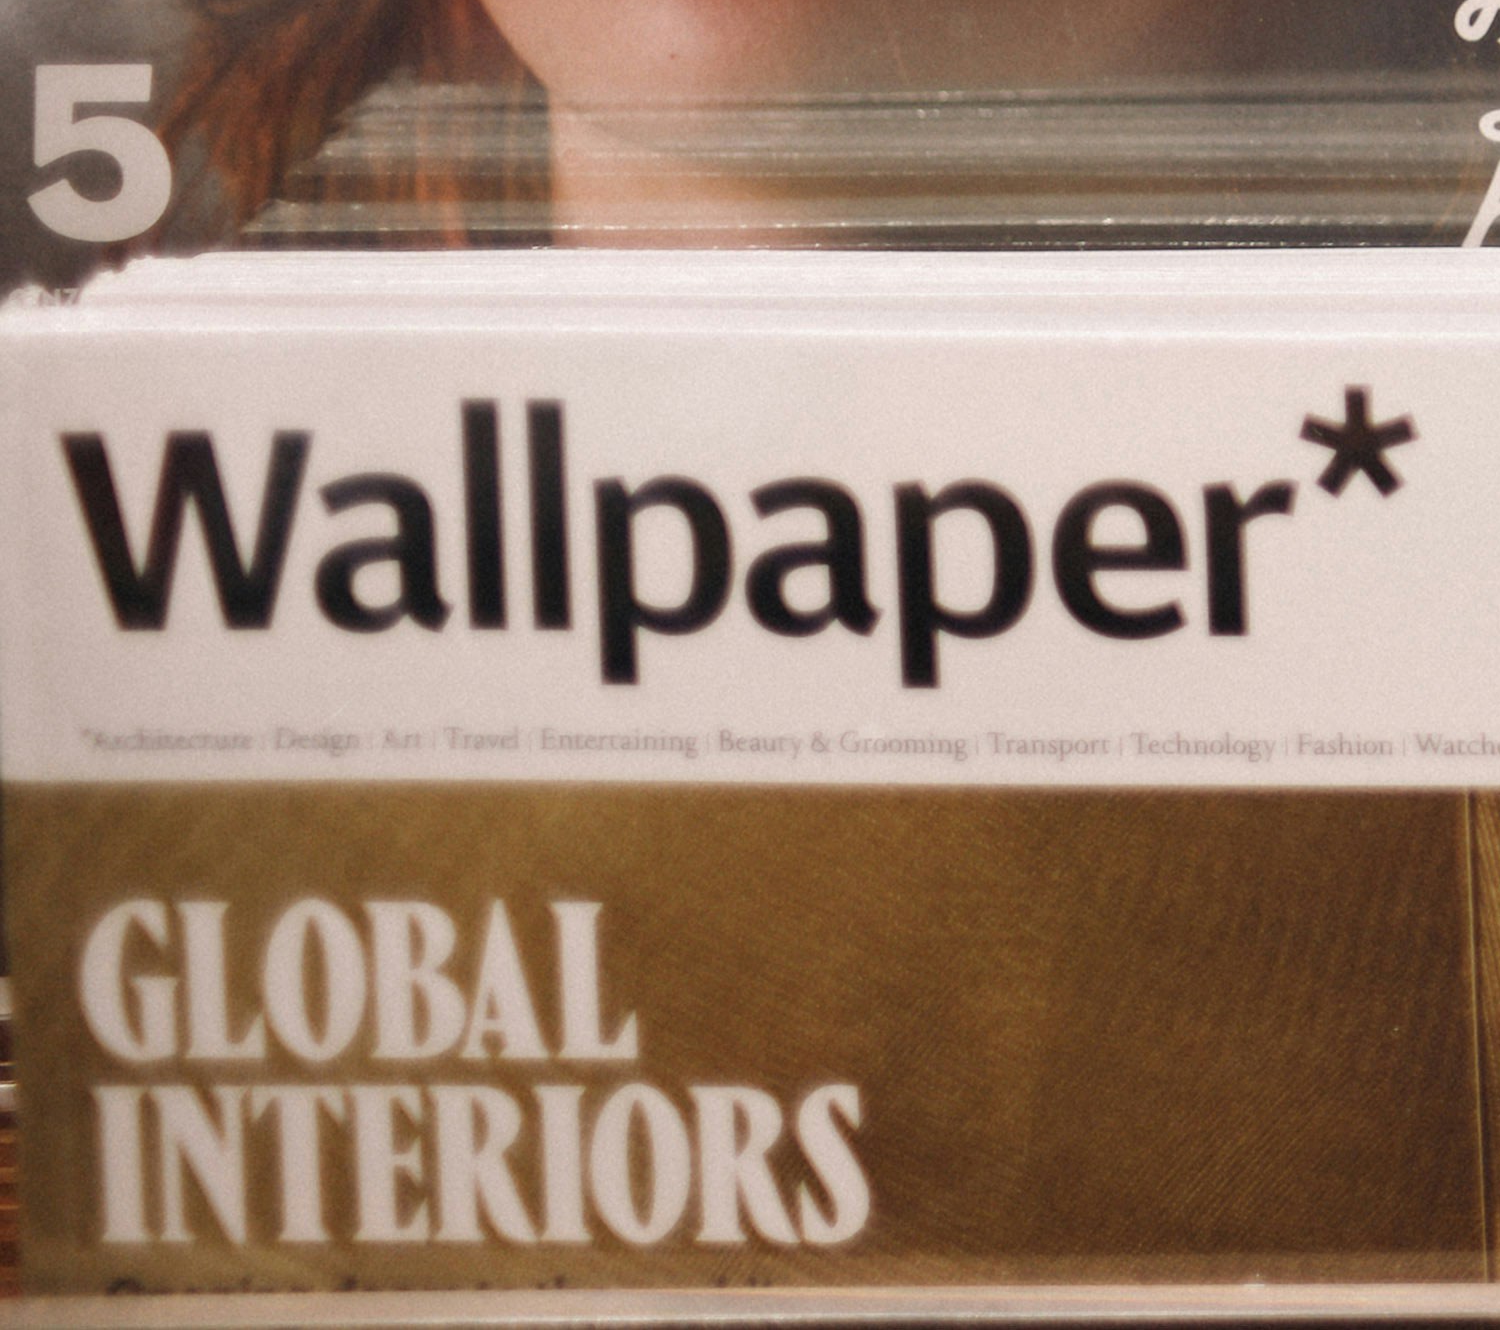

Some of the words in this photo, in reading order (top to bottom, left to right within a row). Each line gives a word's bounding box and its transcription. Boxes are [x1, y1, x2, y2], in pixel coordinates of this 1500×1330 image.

[27, 63, 172, 243] 5
[718, 729, 801, 759] Beauty
[839, 731, 967, 761] Grooming
[986, 730, 1110, 761] Transport
[1130, 732, 1276, 762] Technology
[1296, 731, 1394, 757] Fashion
[79, 895, 639, 1064] GLOBAL
[94, 1080, 873, 1249] INTERIORS
